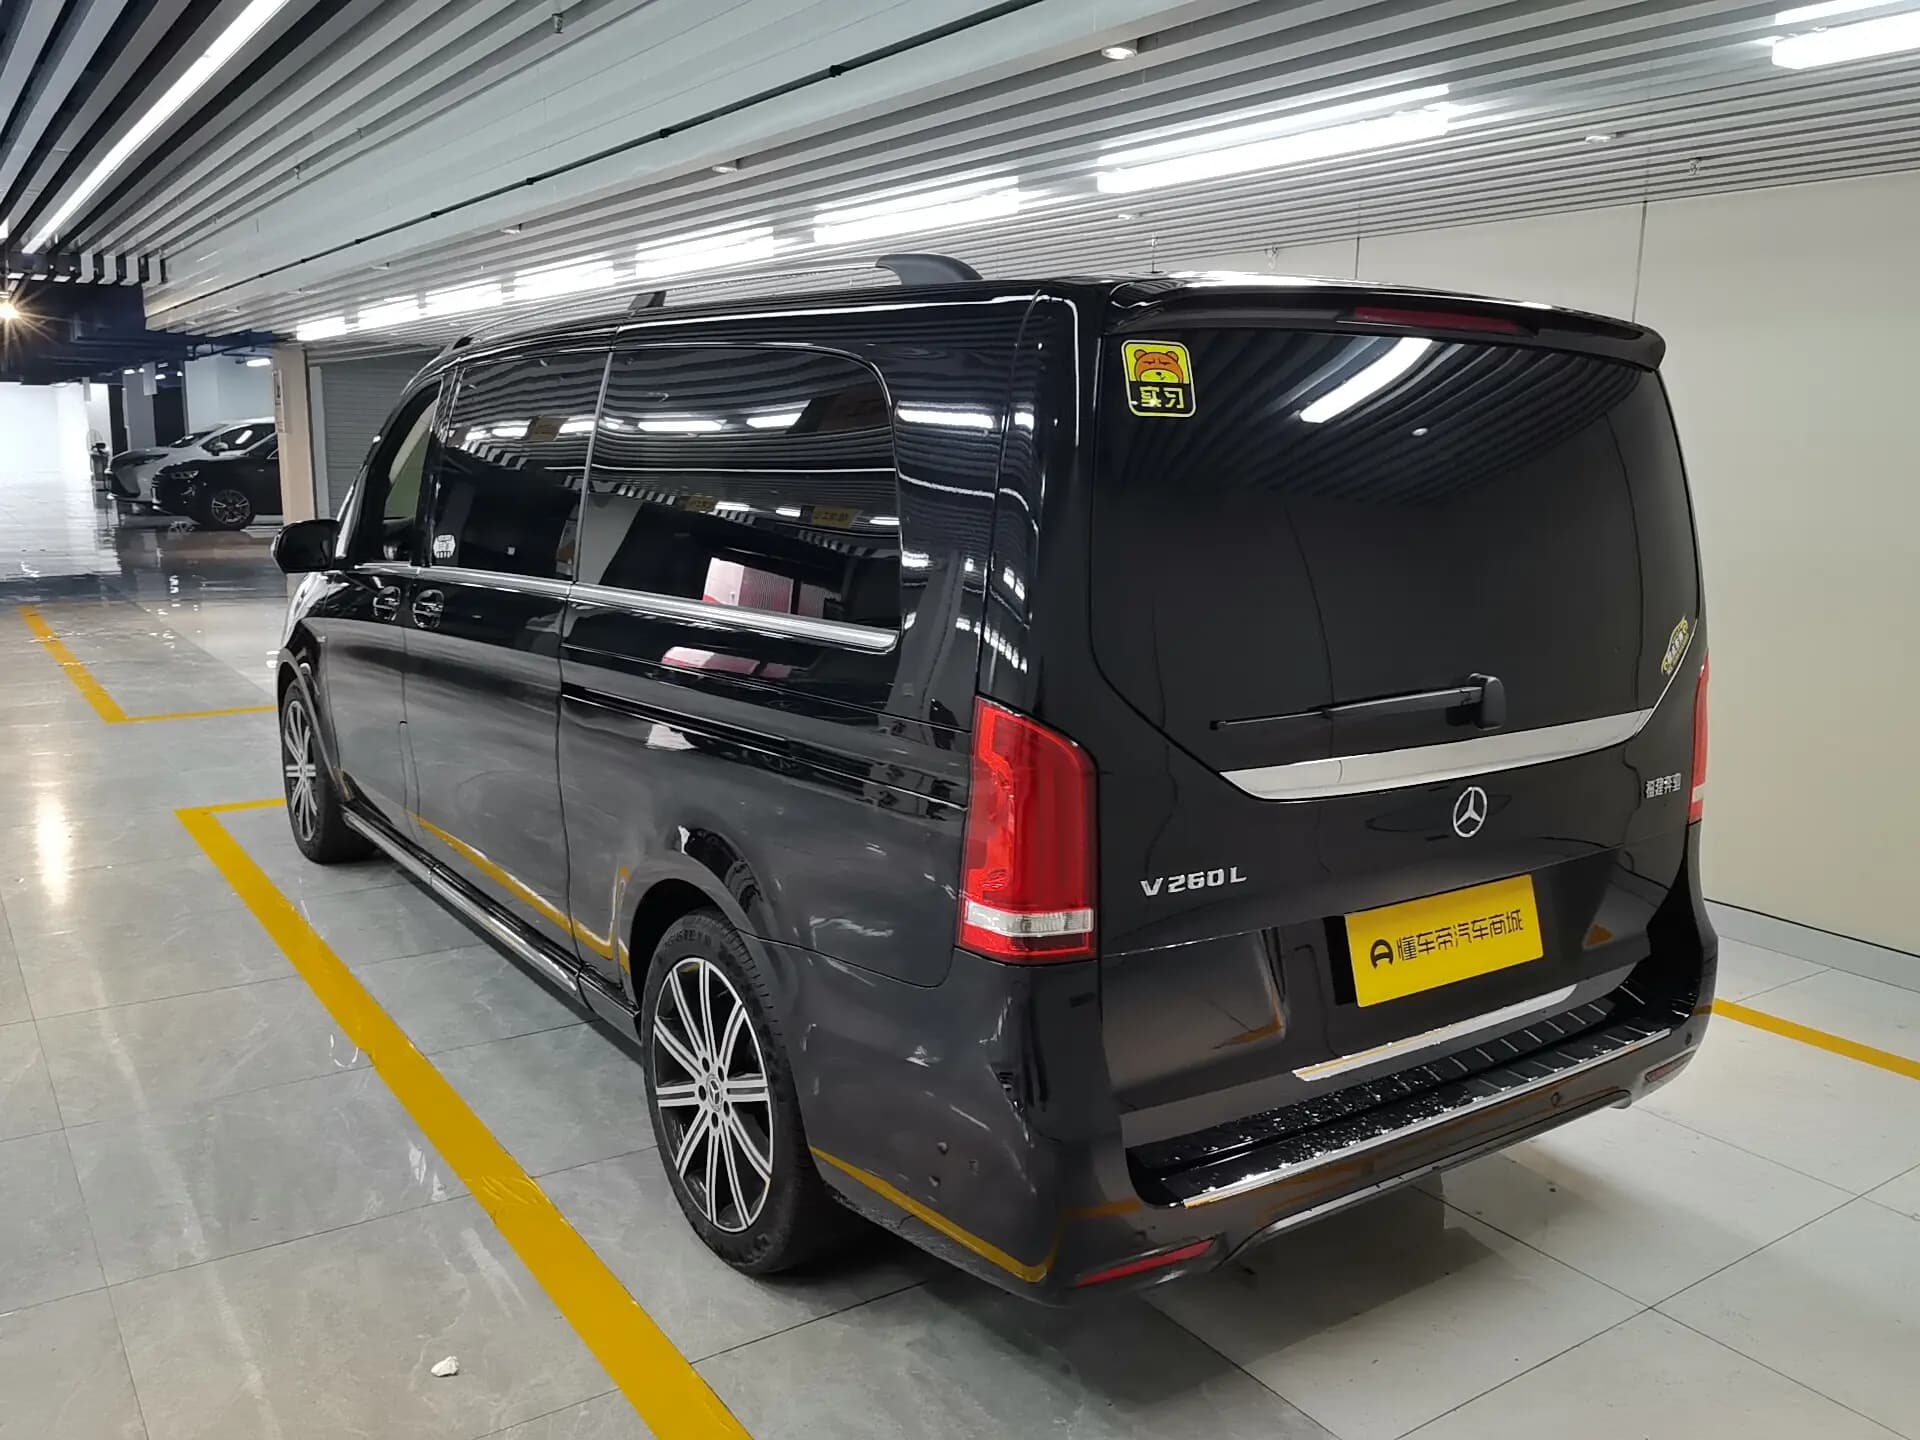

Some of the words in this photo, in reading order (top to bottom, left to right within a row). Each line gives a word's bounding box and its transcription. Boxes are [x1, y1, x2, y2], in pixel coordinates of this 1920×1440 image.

[1139, 386, 1184, 409] 实习
[1396, 909, 1524, 961] 懂车帝汽车商城
